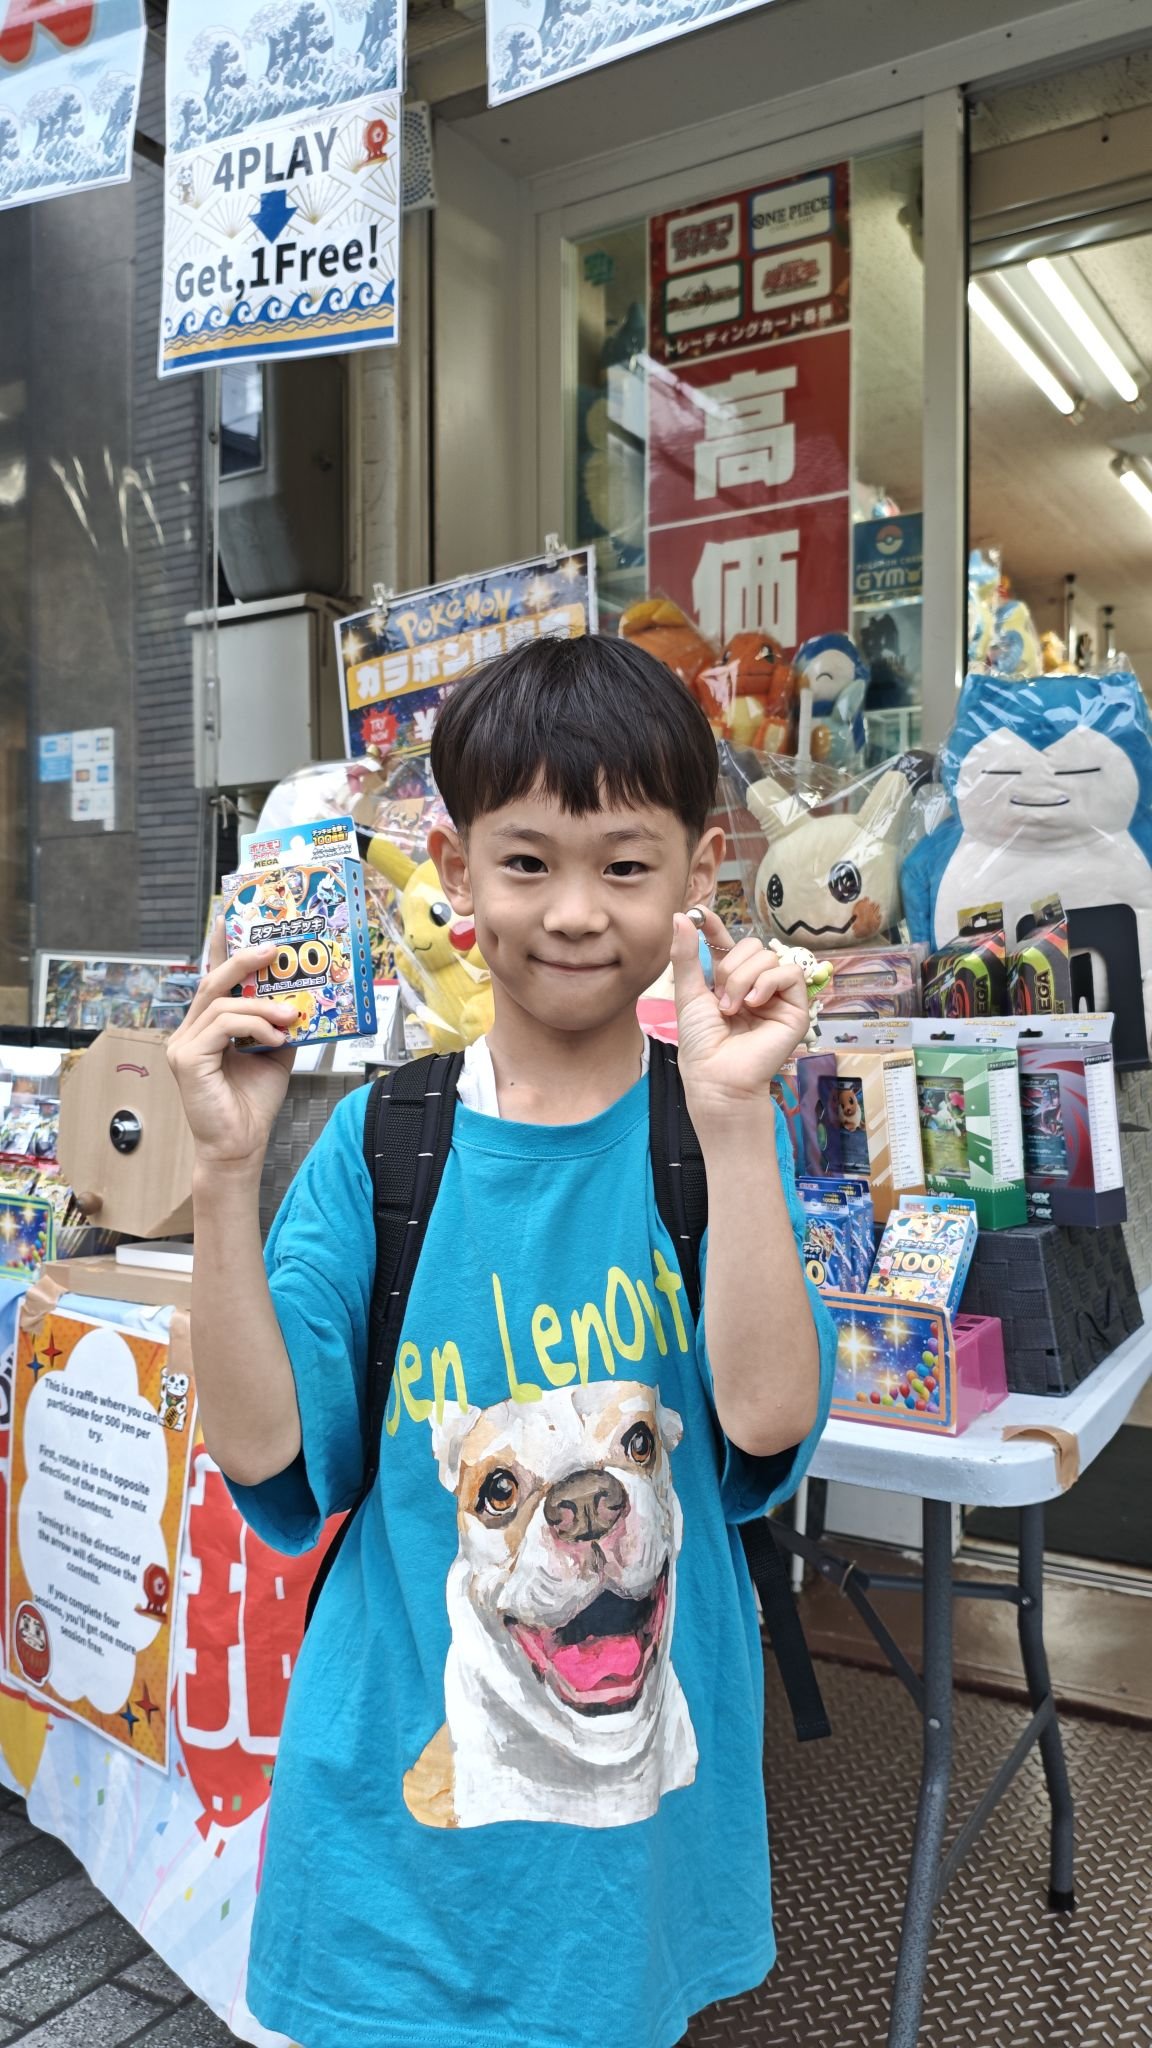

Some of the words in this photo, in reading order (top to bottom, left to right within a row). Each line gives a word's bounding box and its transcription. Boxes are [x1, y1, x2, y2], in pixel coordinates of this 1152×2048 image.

[213, 126, 338, 193] 4PLAY
[752, 208, 787, 230] ONE
[788, 195, 832, 220] PIECE
[855, 567, 905, 591] GYM
[370, 717, 386, 732] TRY
[254, 858, 279, 868] MEGA
[251, 917, 324, 941] スタートデッキ
[892, 1251, 942, 1274] 100
[45, 1378, 59, 1392] This
[61, 1383, 68, 1395] is
[69, 1388, 75, 1397] a
[76, 1390, 98, 1404] raffle
[100, 1397, 127, 1412] where
[128, 1406, 142, 1418] you
[142, 1411, 158, 1424] can
[47, 1398, 89, 1420] participate
[91, 1410, 103, 1423] for
[105, 1415, 120, 1428] 500
[121, 1422, 135, 1434] yen
[136, 1428, 151, 1440] per
[88, 1428, 103, 1443] try.
[39, 1444, 57, 1462] First,
[58, 1454, 80, 1470] rotate
[82, 1461, 89, 1473] it
[90, 1464, 99, 1476] in
[100, 1468, 113, 1481] the
[114, 1475, 150, 1496] opposite
[39, 1462, 71, 1482] direction
[72, 1477, 81, 1487] of
[81, 1479, 95, 1493] the
[96, 1486, 120, 1502] arrow
[121, 1495, 129, 1507] to
[130, 1500, 147, 1513] mix
[64, 1490, 76, 1504] the
[77, 1497, 113, 1519] contents.
[38, 1511, 64, 1536] Turning
[65, 1526, 71, 1537] it
[72, 1528, 79, 1540] in
[80, 1532, 93, 1546] the
[94, 1539, 130, 1561] direction
[131, 1554, 141, 1566] of
[38, 1529, 50, 1542] the
[51, 1537, 71, 1553] arrow
[72, 1547, 86, 1560] will
[87, 1552, 121, 1576] dispense
[123, 1568, 137, 1583] the
[66, 1562, 101, 1585] contents.
[48, 1584, 54, 1595] If
[54, 1589, 67, 1602] you
[69, 1597, 102, 1620] complete
[103, 1610, 120, 1629] four
[34, 1594, 64, 1619] sessions,
[65, 1611, 86, 1629] you'll
[86, 1623, 98, 1635] get
[100, 1630, 114, 1644] one
[115, 1638, 137, 1655] more
[60, 1625, 86, 1646] session
[87, 1641, 104, 1656] free.
